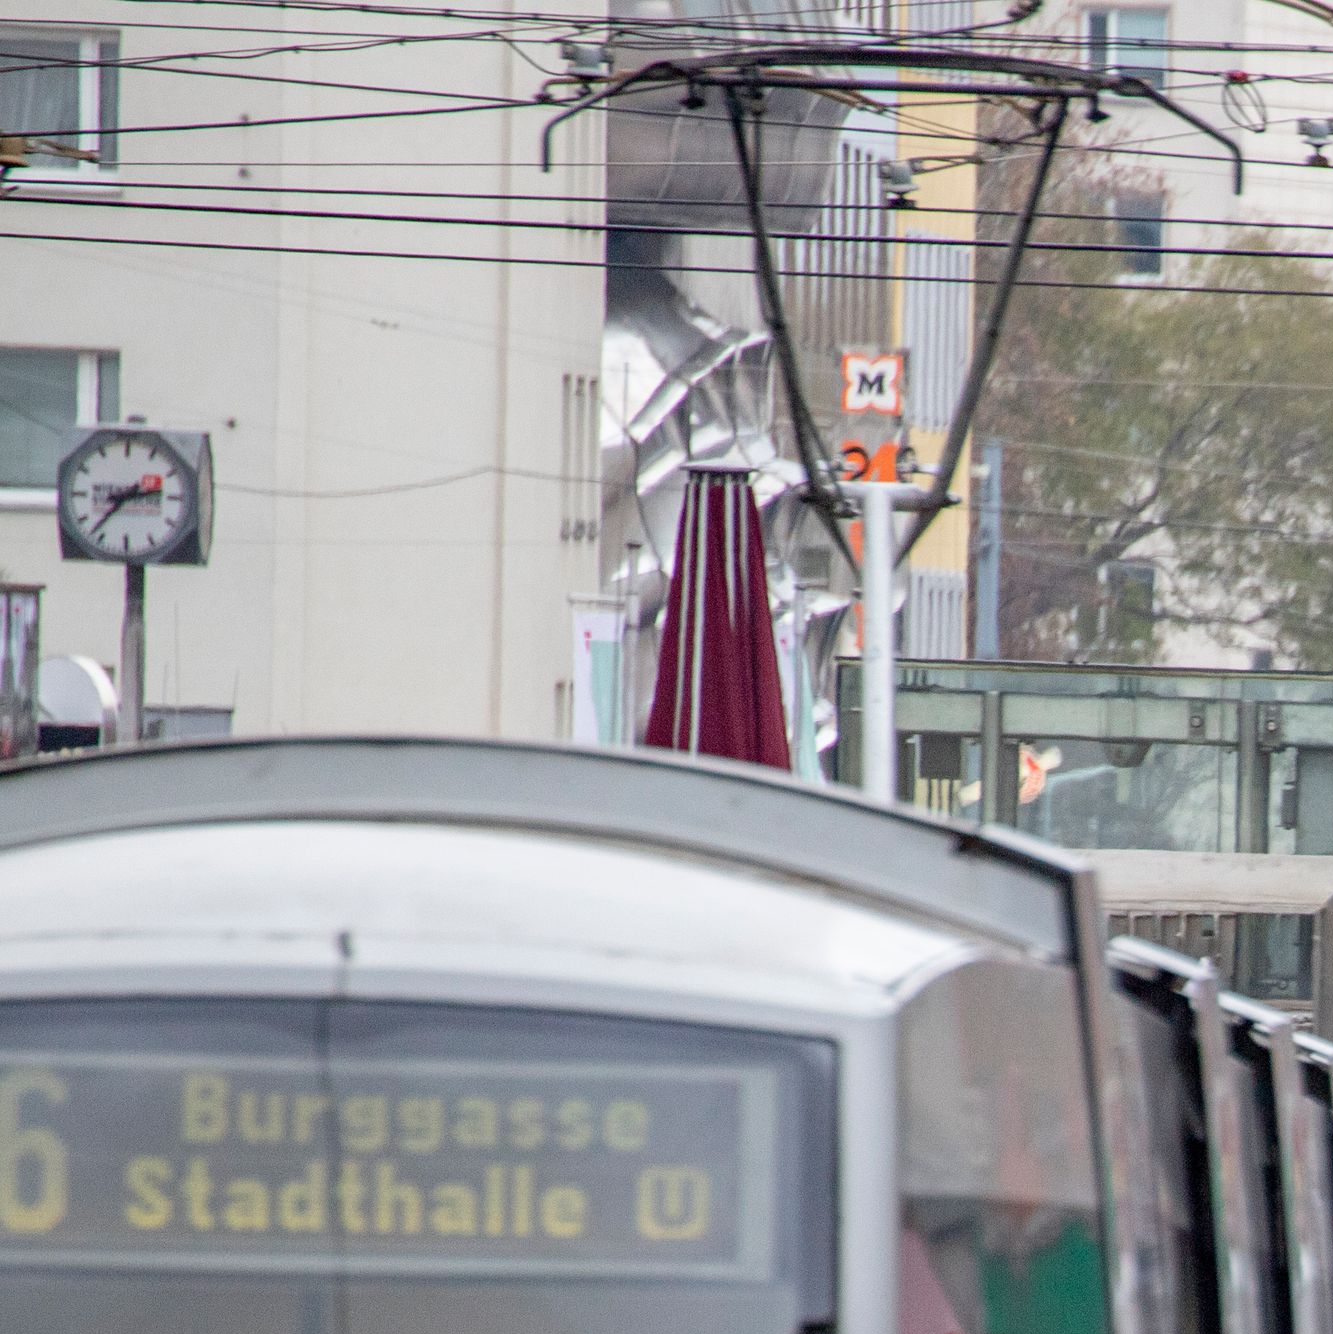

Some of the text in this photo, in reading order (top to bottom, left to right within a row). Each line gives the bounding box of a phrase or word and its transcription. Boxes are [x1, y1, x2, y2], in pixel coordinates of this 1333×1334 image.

[857, 373, 885, 394] M
[179, 1072, 651, 1152] Burggasse
[125, 1156, 590, 1239] Stadthalle
